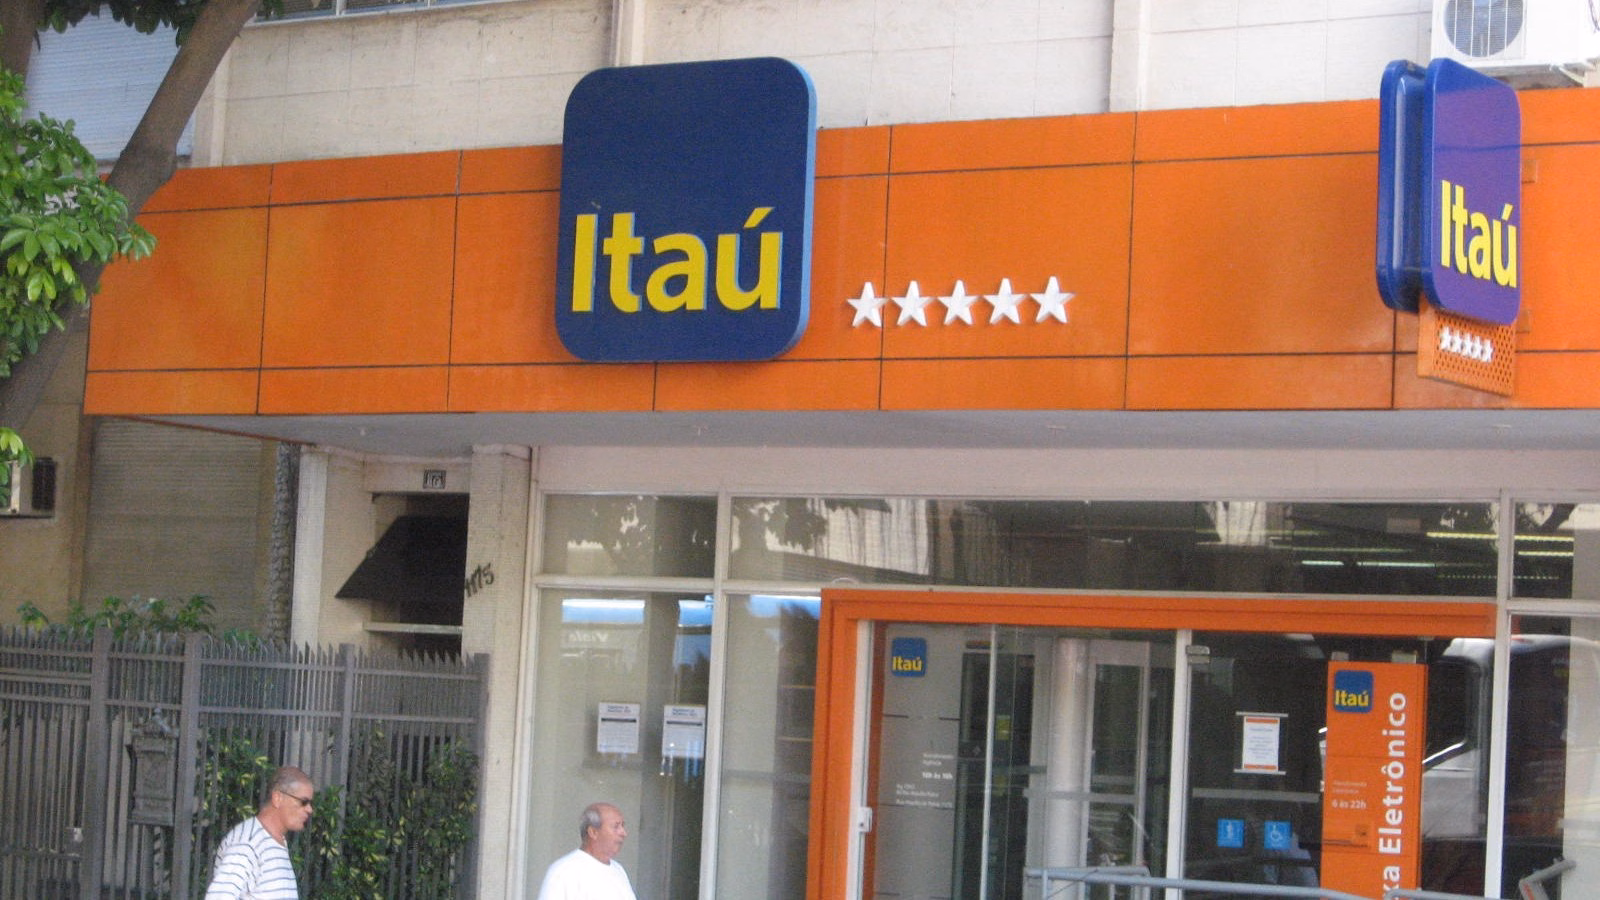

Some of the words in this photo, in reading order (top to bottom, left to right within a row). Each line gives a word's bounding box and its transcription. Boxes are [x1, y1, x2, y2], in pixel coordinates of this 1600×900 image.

[572, 206, 784, 314] Itaú
[1440, 179, 1518, 289] Itaú
[892, 656, 923, 672] Itaú
[1334, 689, 1370, 708] Itaú
[1377, 692, 1408, 855] Eletrônico
